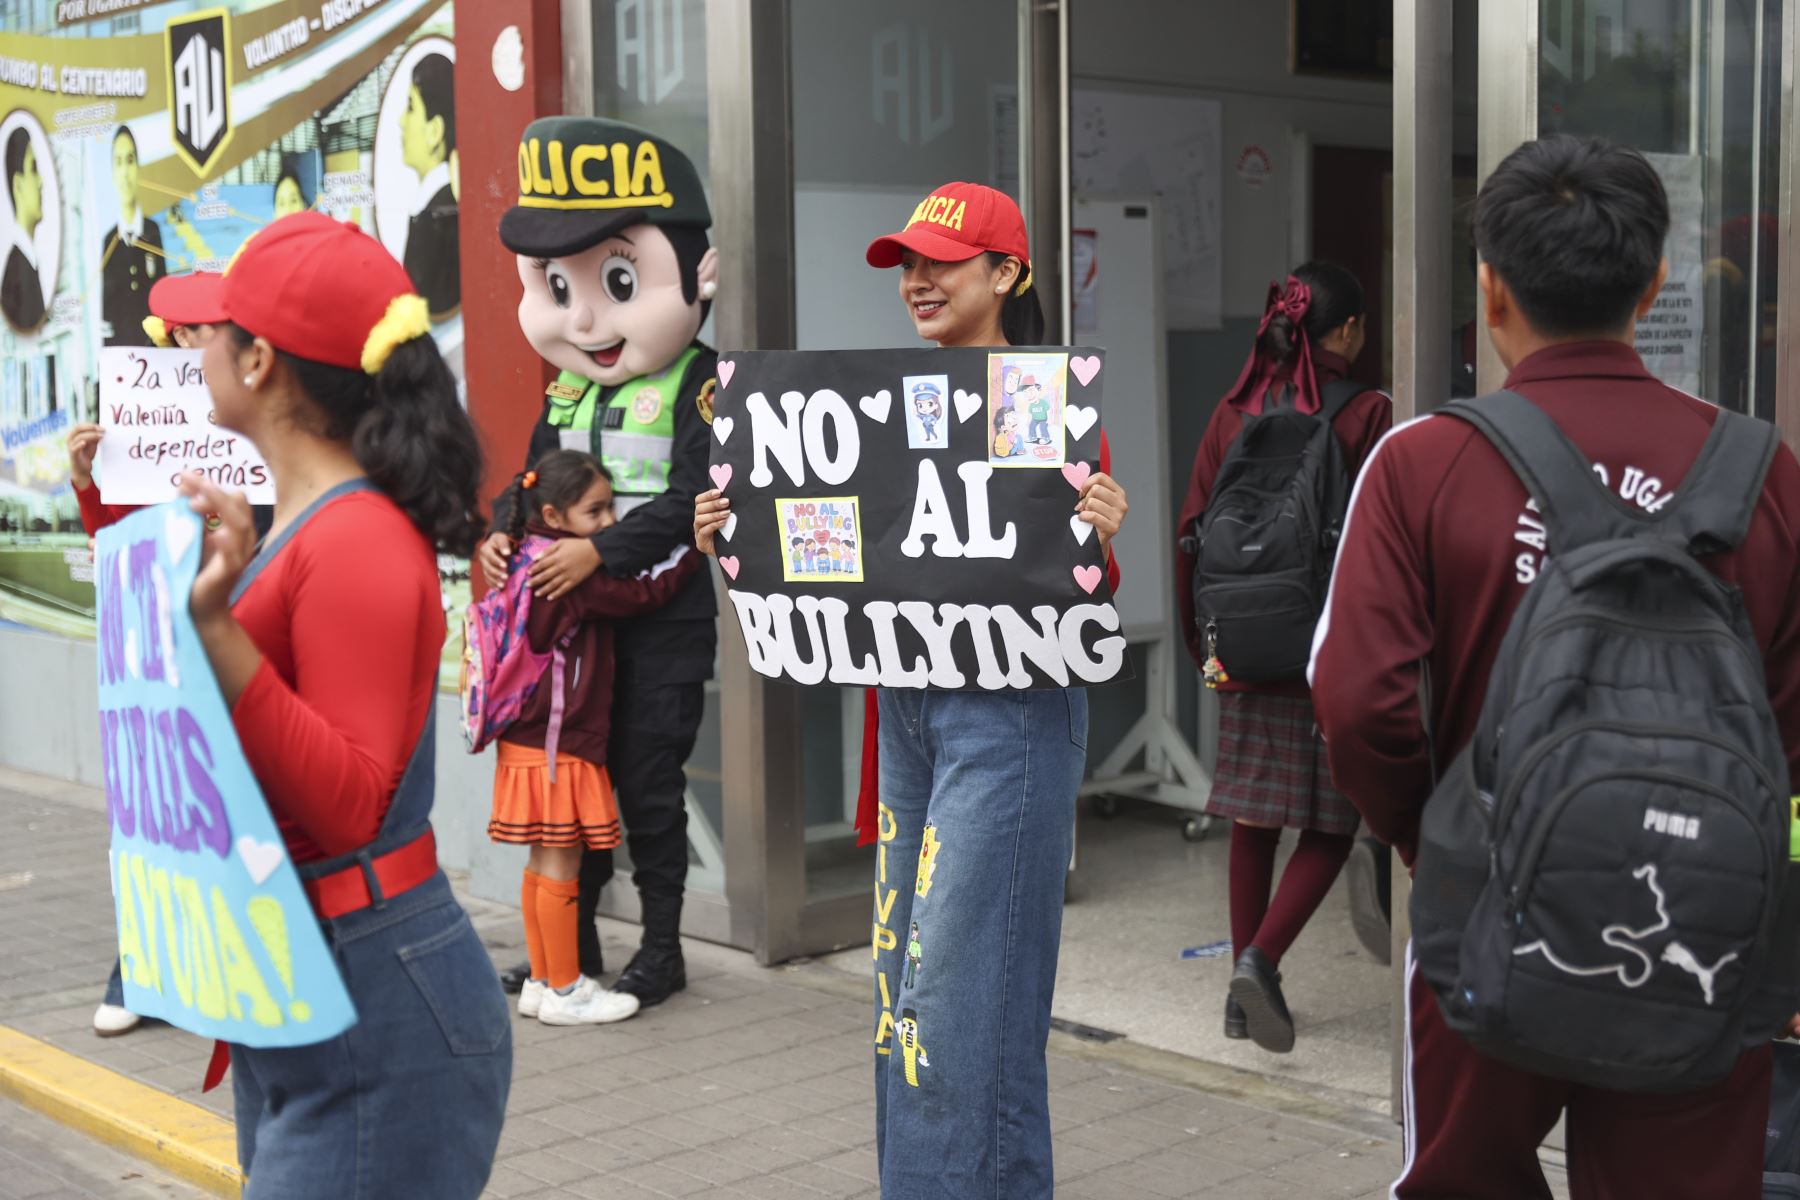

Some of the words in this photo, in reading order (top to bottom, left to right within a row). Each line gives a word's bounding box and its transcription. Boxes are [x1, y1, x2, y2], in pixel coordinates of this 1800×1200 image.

[243, 15, 309, 70] VOLUNTAD
[40, 62, 57, 93] AL
[60, 66, 148, 97] CENTENARIO
[128, 434, 237, 466] defender
[745, 388, 861, 488] NO
[787, 515, 852, 534] BULLYING
[794, 503, 816, 518] NO
[819, 503, 839, 516] AL
[900, 458, 1017, 559] AL
[728, 588, 1127, 690] BULLYING
[1643, 807, 1701, 840] PUMA
